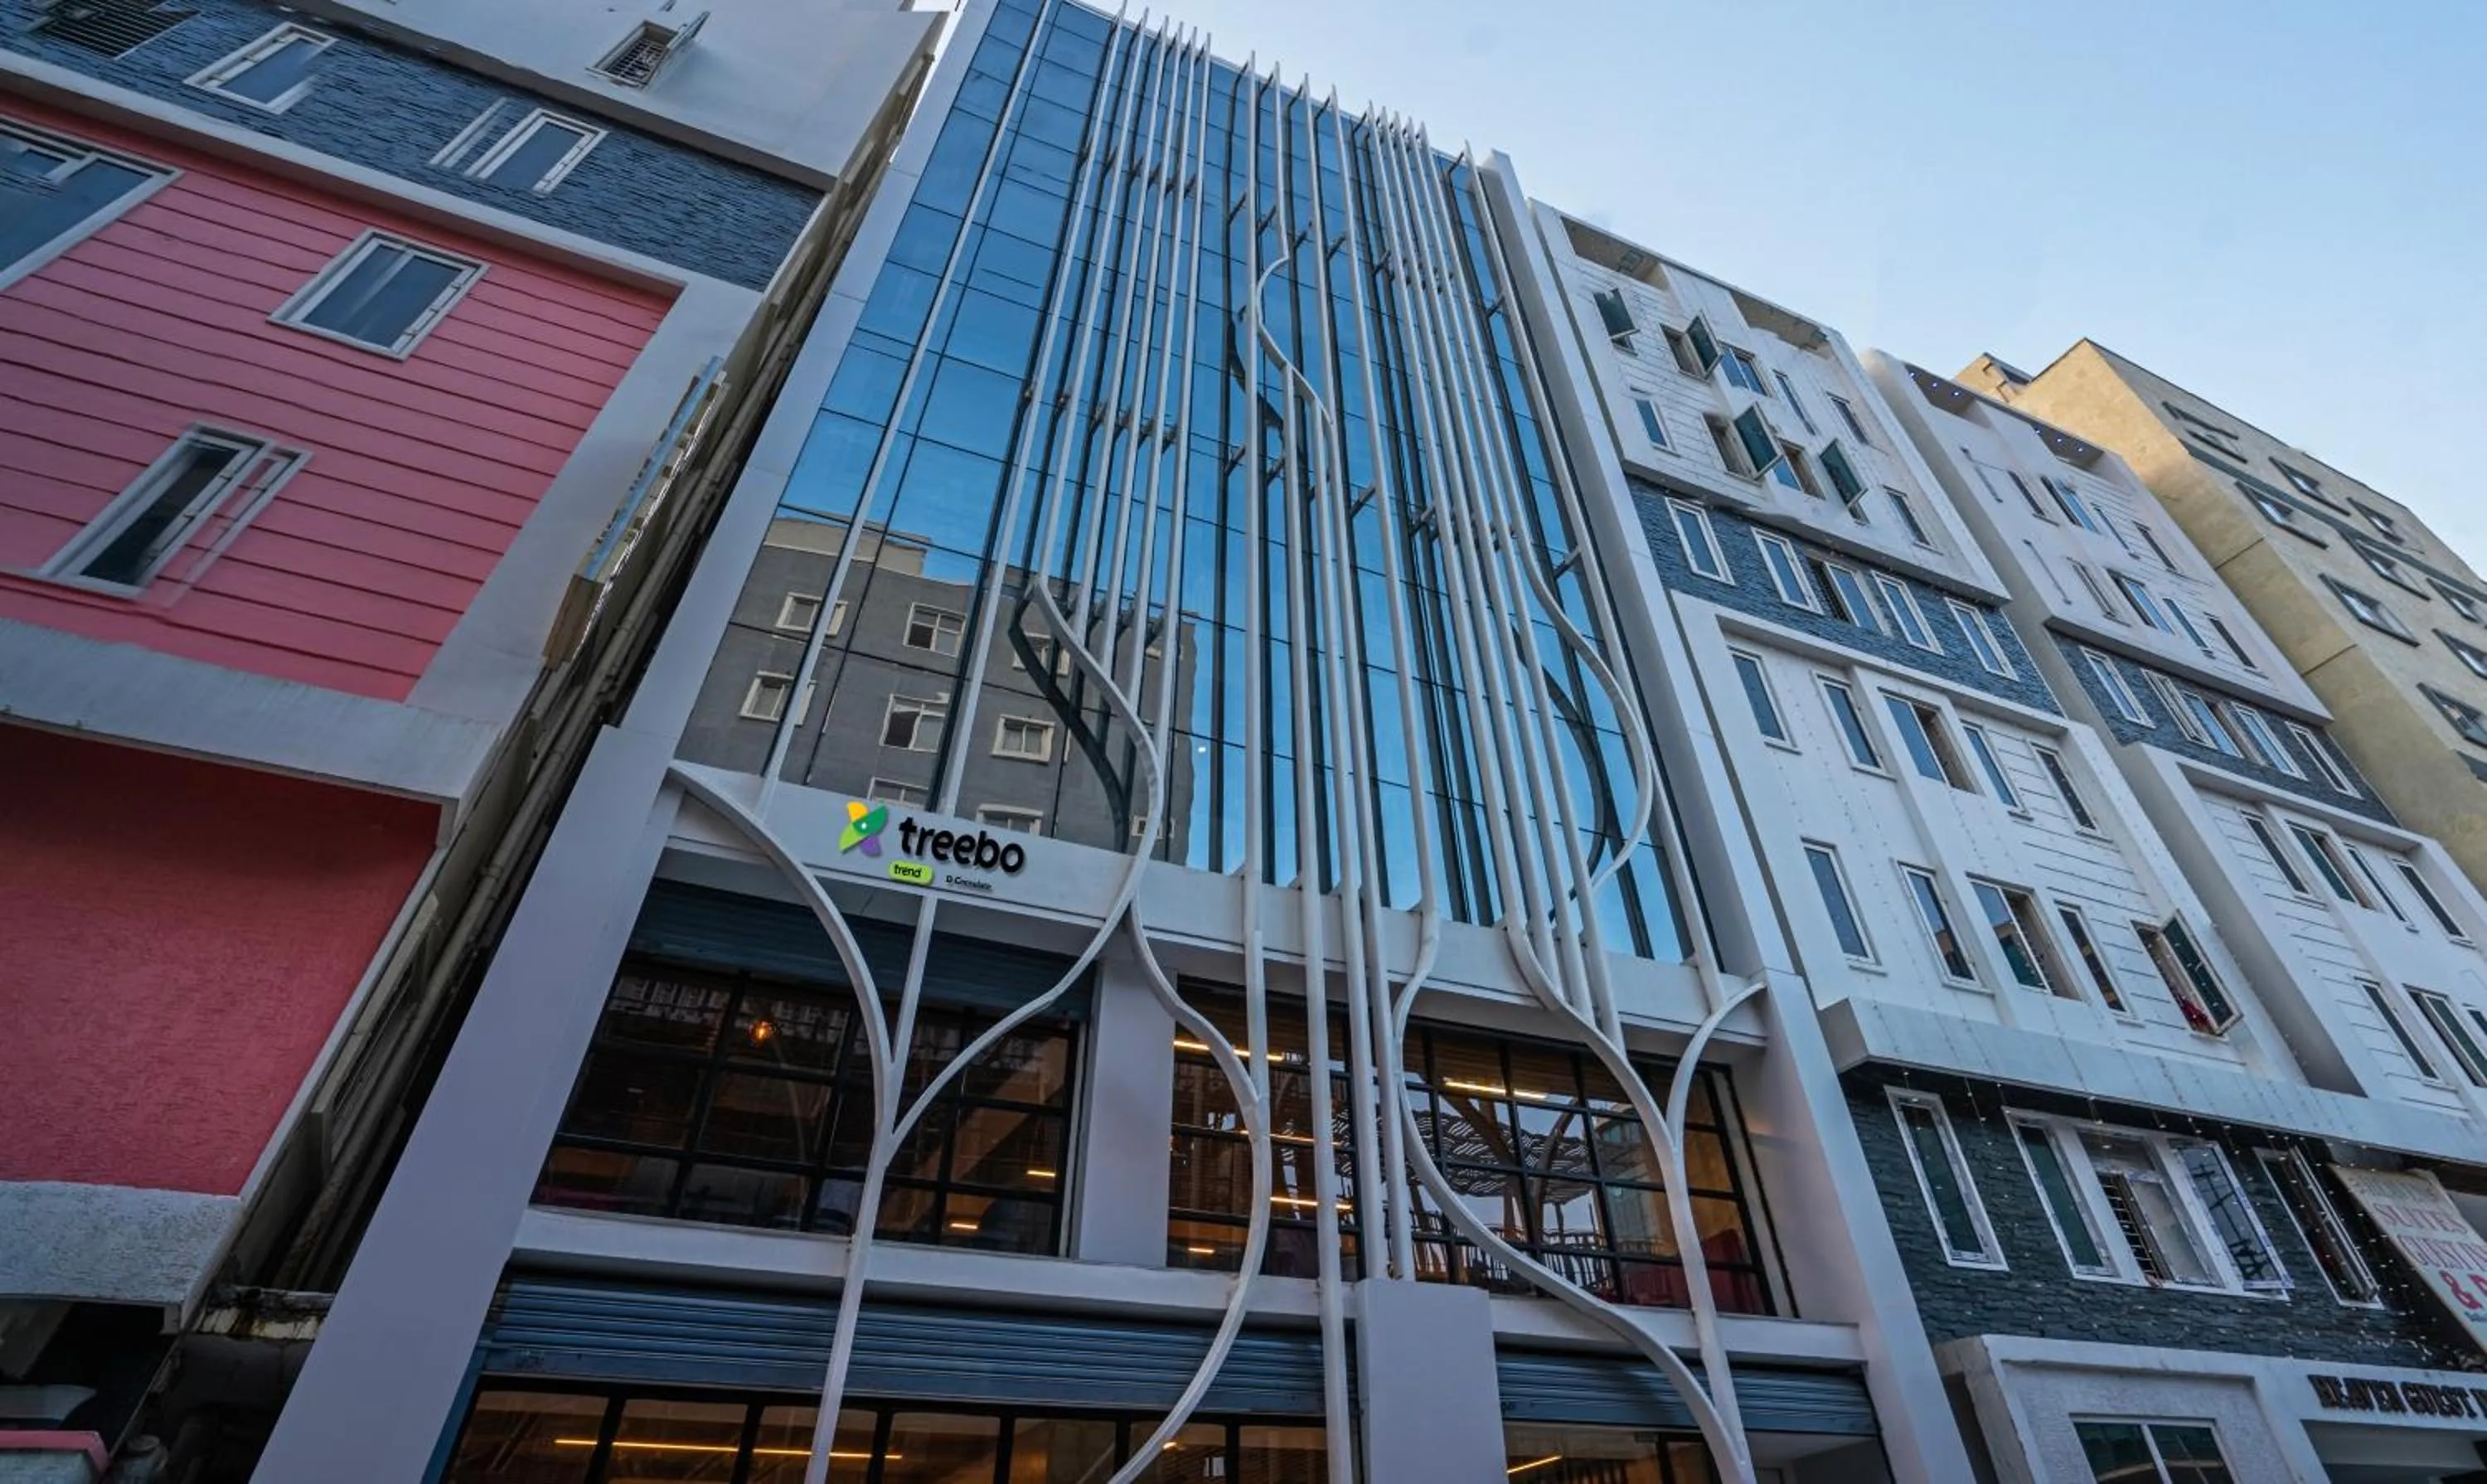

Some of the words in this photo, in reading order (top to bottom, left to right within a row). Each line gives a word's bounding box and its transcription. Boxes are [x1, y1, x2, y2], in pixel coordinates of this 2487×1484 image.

[898, 816, 1025, 874] treebo
[894, 863, 922, 878] trend
[2373, 1203, 2468, 1234] SUITES
[2438, 1269, 2484, 1310] &
[2400, 1381, 2478, 1420] GUEST
